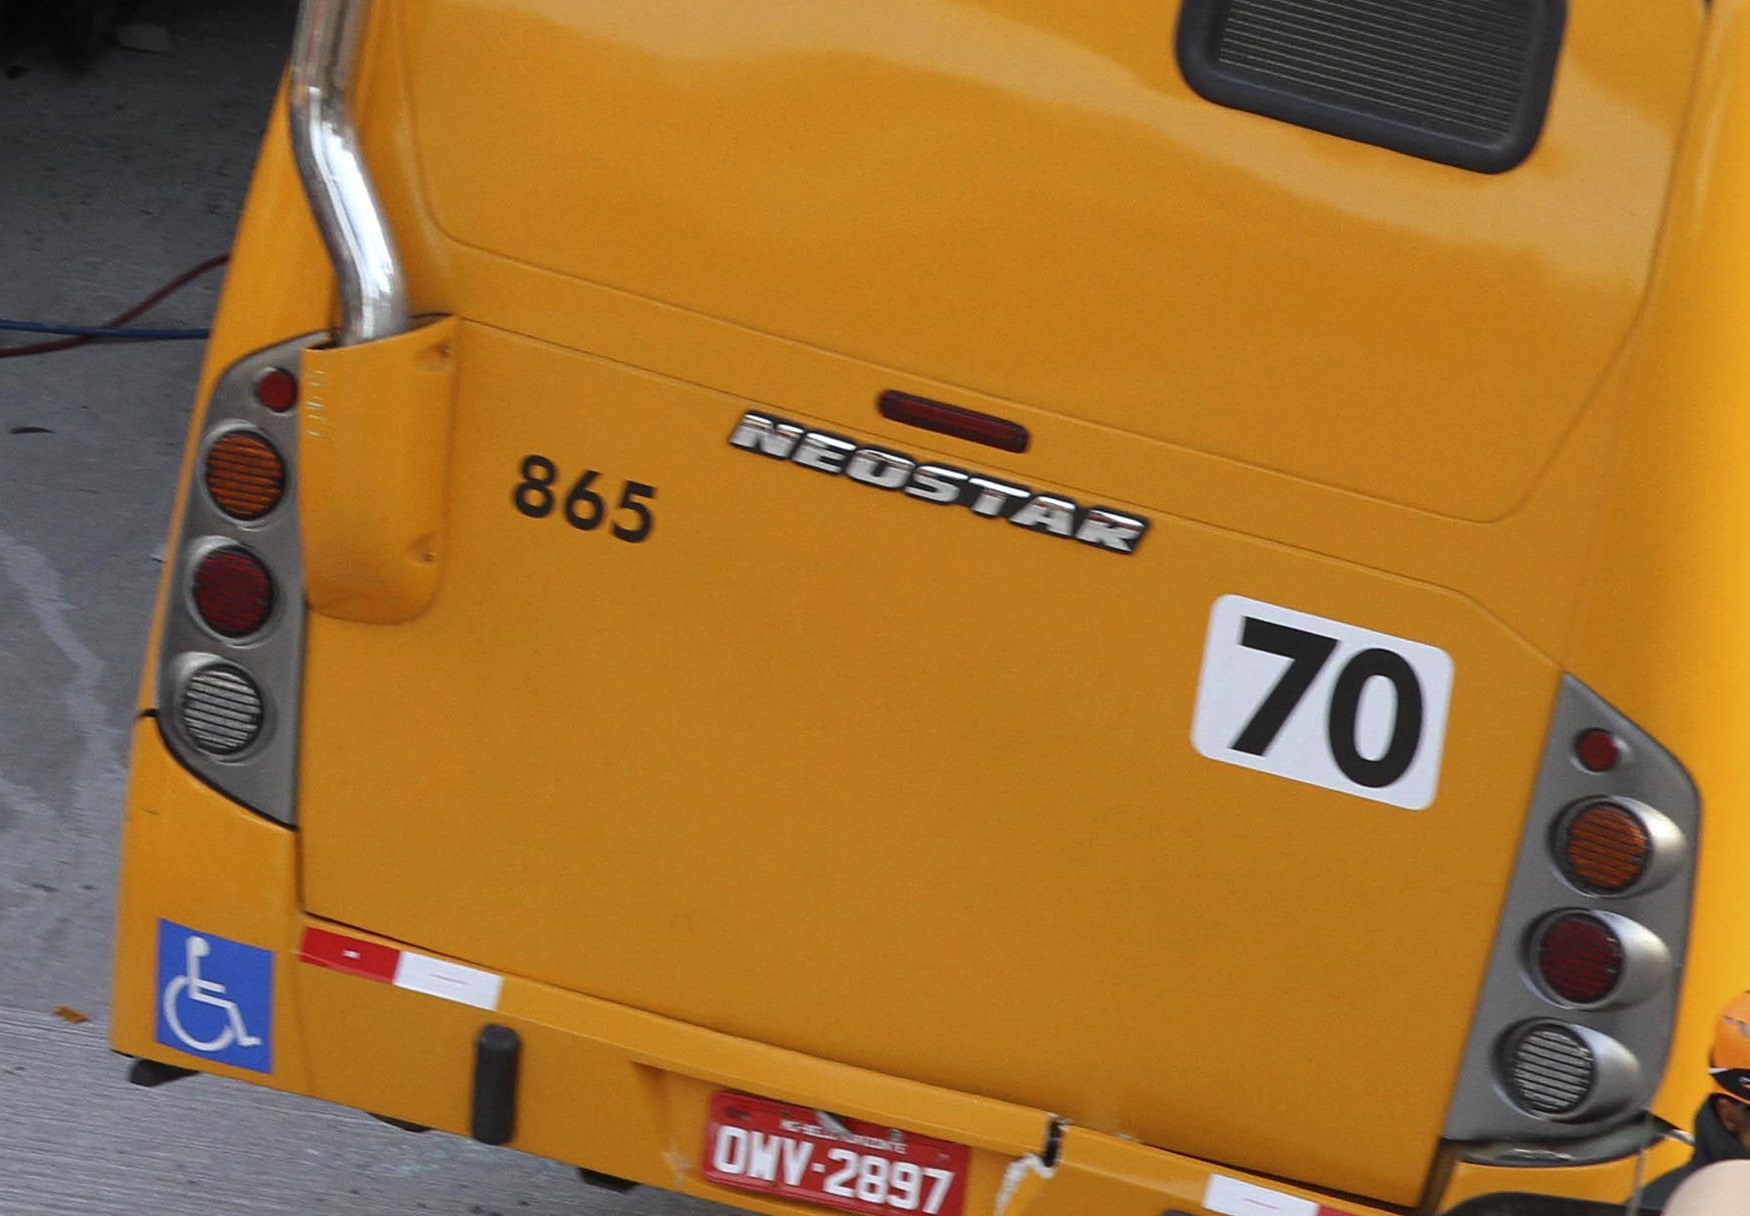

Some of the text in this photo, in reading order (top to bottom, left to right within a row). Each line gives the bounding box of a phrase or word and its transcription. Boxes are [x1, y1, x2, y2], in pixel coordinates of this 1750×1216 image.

[514, 454, 657, 544] 865
[729, 410, 1148, 554] NEOSTAR
[1229, 615, 1424, 789] 70
[713, 1125, 955, 1215] OWV-2897
